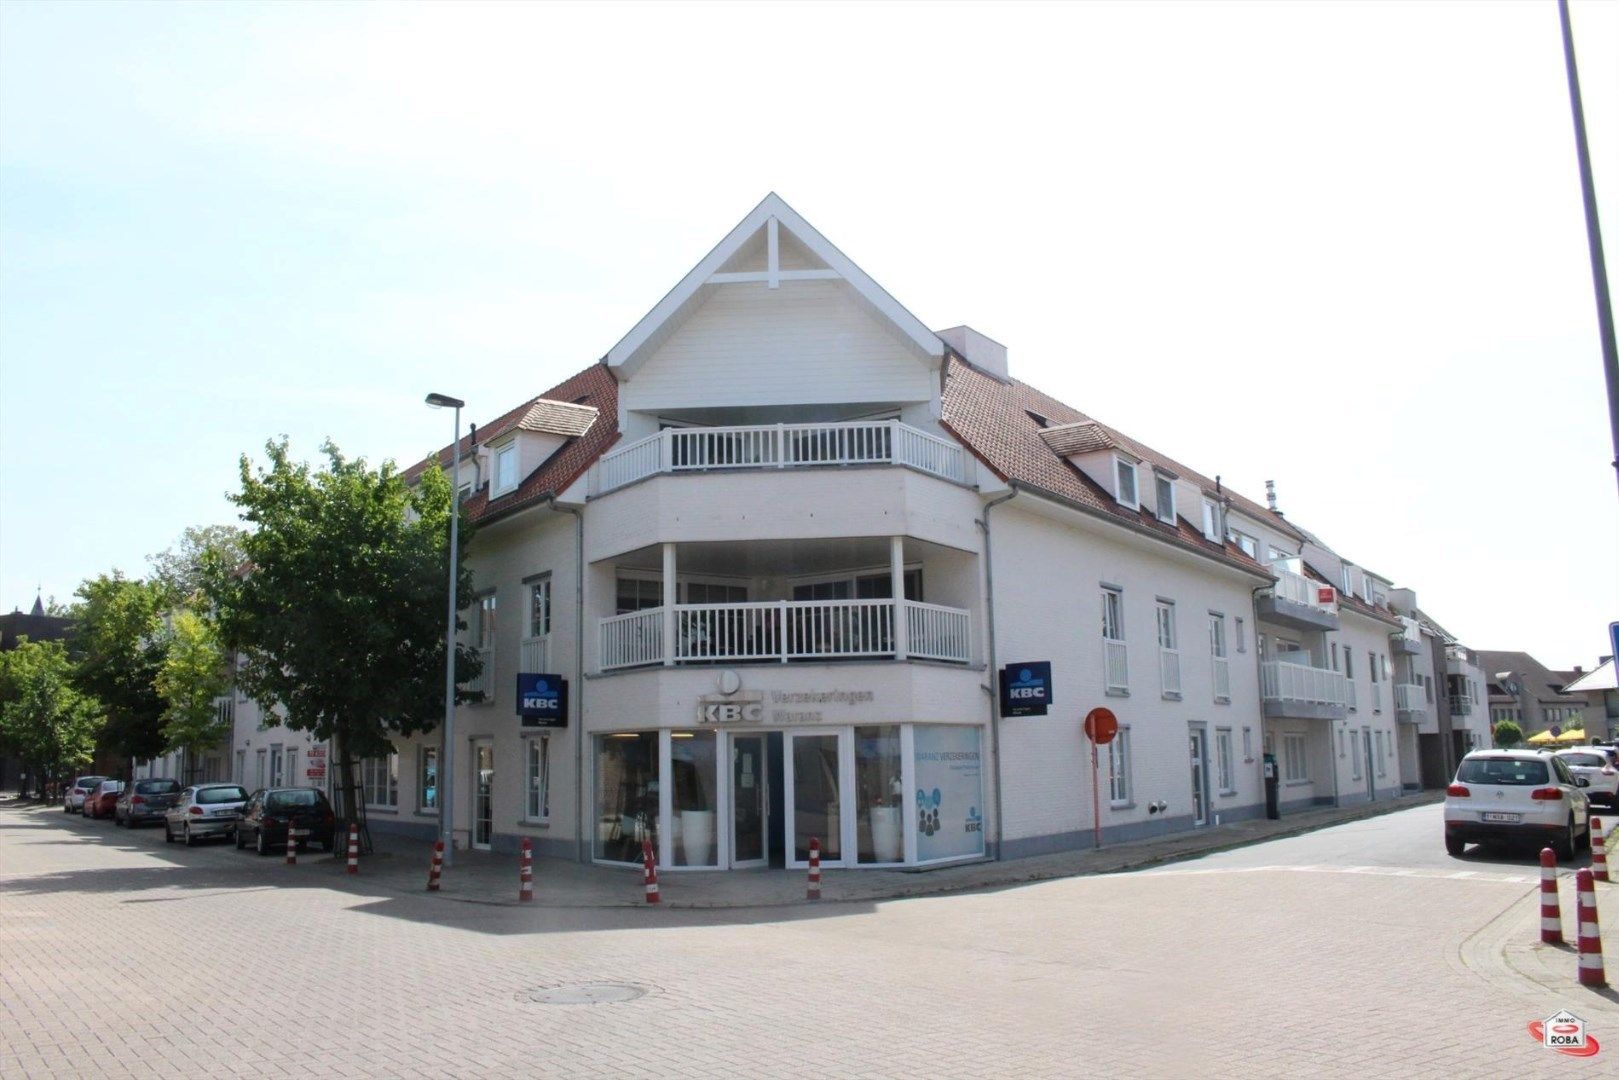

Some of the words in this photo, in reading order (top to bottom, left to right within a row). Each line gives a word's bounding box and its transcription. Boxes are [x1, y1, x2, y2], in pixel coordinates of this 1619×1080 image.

[771, 689, 874, 705] Verzekeringen
[1010, 687, 1044, 699] KBC
[523, 698, 558, 709] KBC
[697, 704, 765, 723] KBC
[964, 822, 982, 832] KBC
